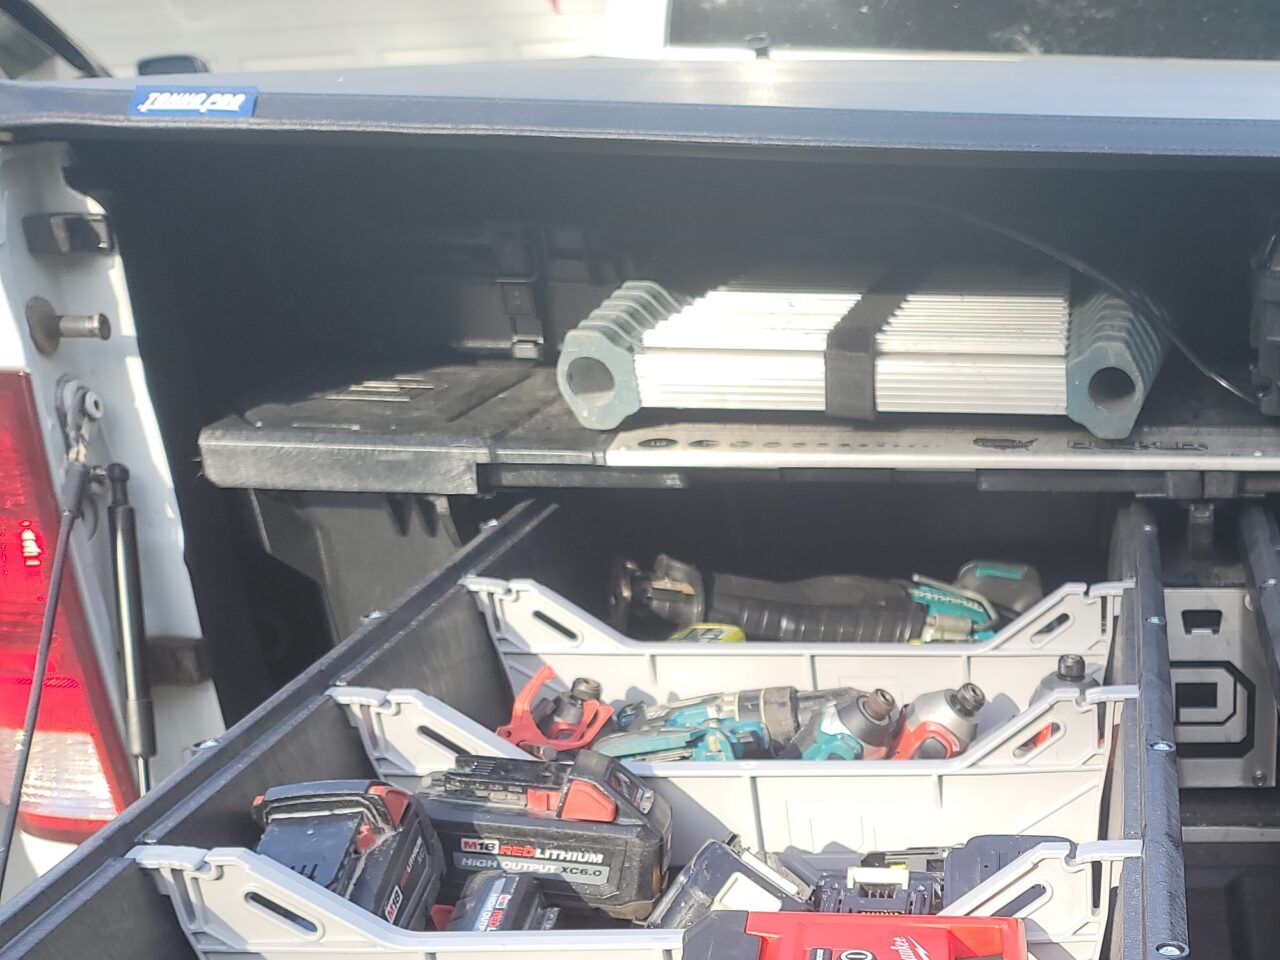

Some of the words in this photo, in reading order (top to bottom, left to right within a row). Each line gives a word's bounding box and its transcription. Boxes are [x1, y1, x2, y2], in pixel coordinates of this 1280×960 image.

[462, 840, 496, 852] M18
[500, 842, 605, 864] REDLITHIUM
[461, 857, 498, 869] HIGH
[501, 860, 558, 874] OUTPUT
[561, 866, 603, 878] XC6.0
